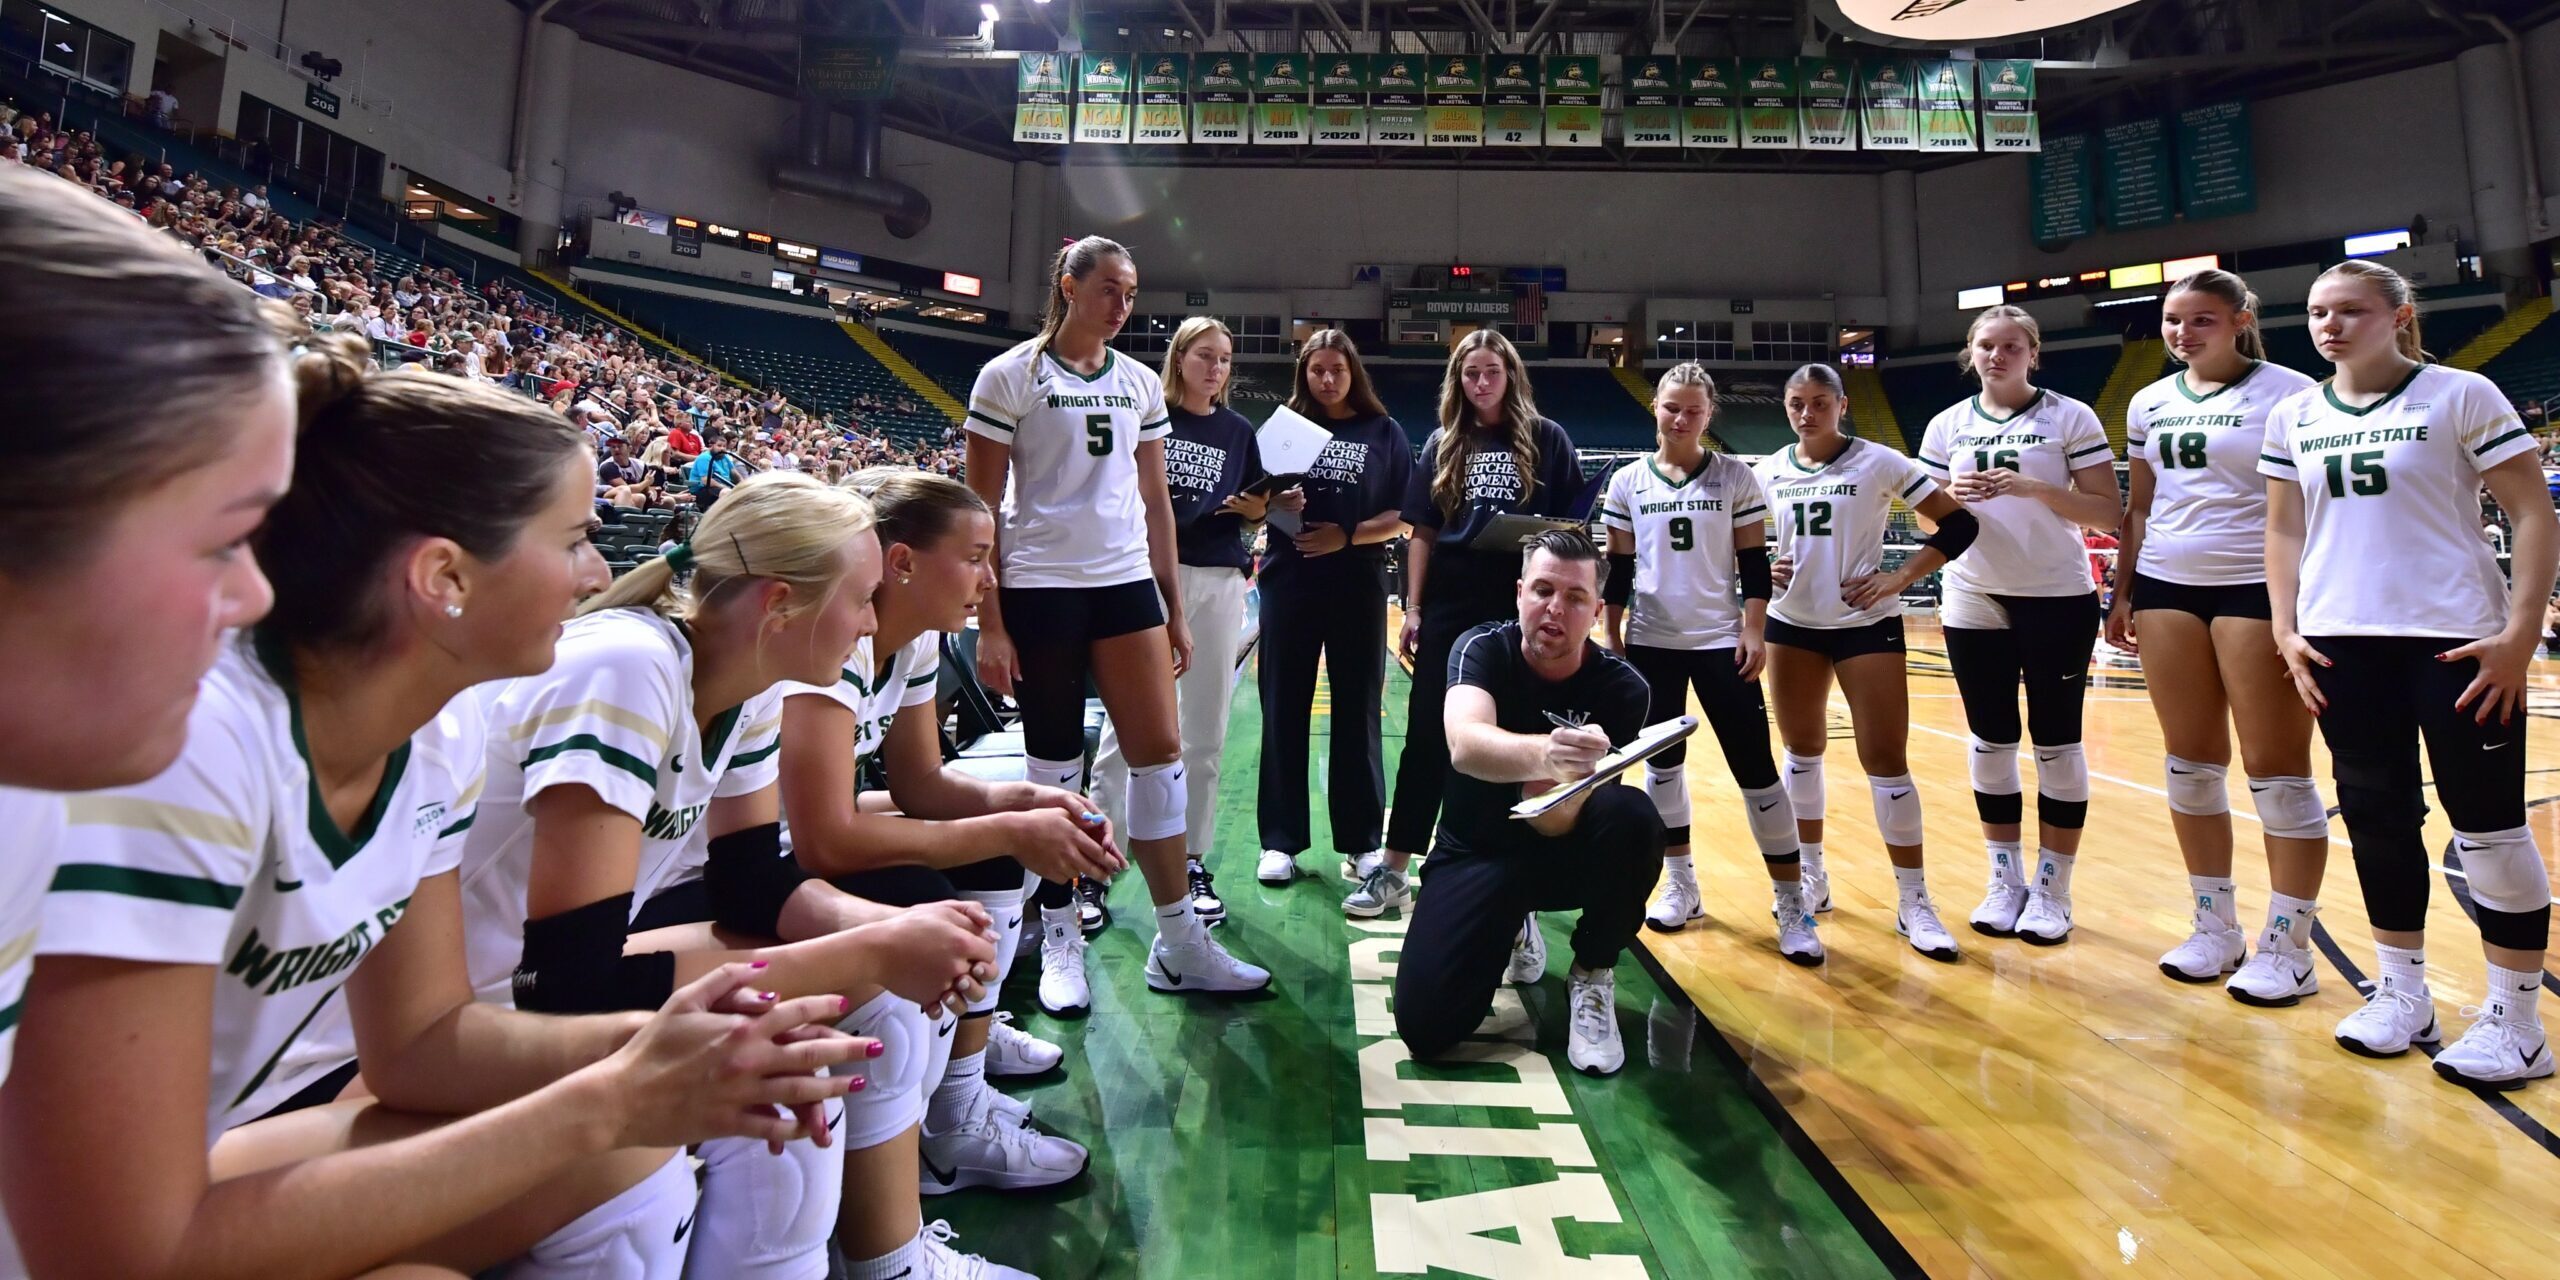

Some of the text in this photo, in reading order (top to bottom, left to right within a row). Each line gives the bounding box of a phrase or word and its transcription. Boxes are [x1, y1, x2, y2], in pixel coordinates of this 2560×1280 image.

[312, 97, 335, 113] 208
[1023, 112, 1063, 128] NCAA
[1083, 108, 1124, 126] NCAA
[1142, 111, 1180, 127] NCAA
[1203, 111, 1239, 125] NCAA
[1022, 131, 1063, 140] 1983
[1083, 129, 1122, 138] 1993
[1139, 129, 1183, 138] 2007
[1203, 130, 1238, 138] 2018
[1264, 130, 1298, 138] 2019
[1320, 131, 1361, 140] 2020
[1379, 132, 1415, 140] 2021
[1453, 134, 1477, 142] WINS
[1505, 132, 1522, 142] 42
[1569, 133, 1577, 143] 4
[1692, 135, 1727, 143] 2015
[1752, 135, 1787, 143] 2016
[1809, 136, 1845, 144] 2017
[1873, 137, 1908, 145] 2018
[1930, 138, 1967, 146] 2019
[1995, 138, 2030, 146] 2021
[676, 246, 698, 255] 209
[823, 255, 858, 266] BUD LIGHT
[1427, 302, 1510, 314] ROWDY RAIDERS
[1047, 395, 1100, 408] WRIGHT
[2150, 415, 2243, 429] WRIGHT STATE
[1086, 414, 1113, 456] 5
[1959, 434, 2046, 448] WRIGHT STATE
[2300, 426, 2429, 453] WRIGHT STATE
[1163, 437, 1226, 461] VERYONE
[1327, 440, 1369, 453] RYONE
[2158, 432, 2207, 469] 18
[1315, 457, 1365, 473] OMEN'S
[1308, 468, 1358, 484] SPORTS.
[2323, 450, 2388, 498] 15
[1465, 486, 1516, 500] SPORTS.
[1777, 484, 1857, 499] WRIGHT STATE
[1640, 500, 1723, 515] WRIGHT STATE
[1793, 501, 1832, 536] 12
[1669, 517, 1693, 551] 9
[226, 921, 372, 996] WRIGHT
